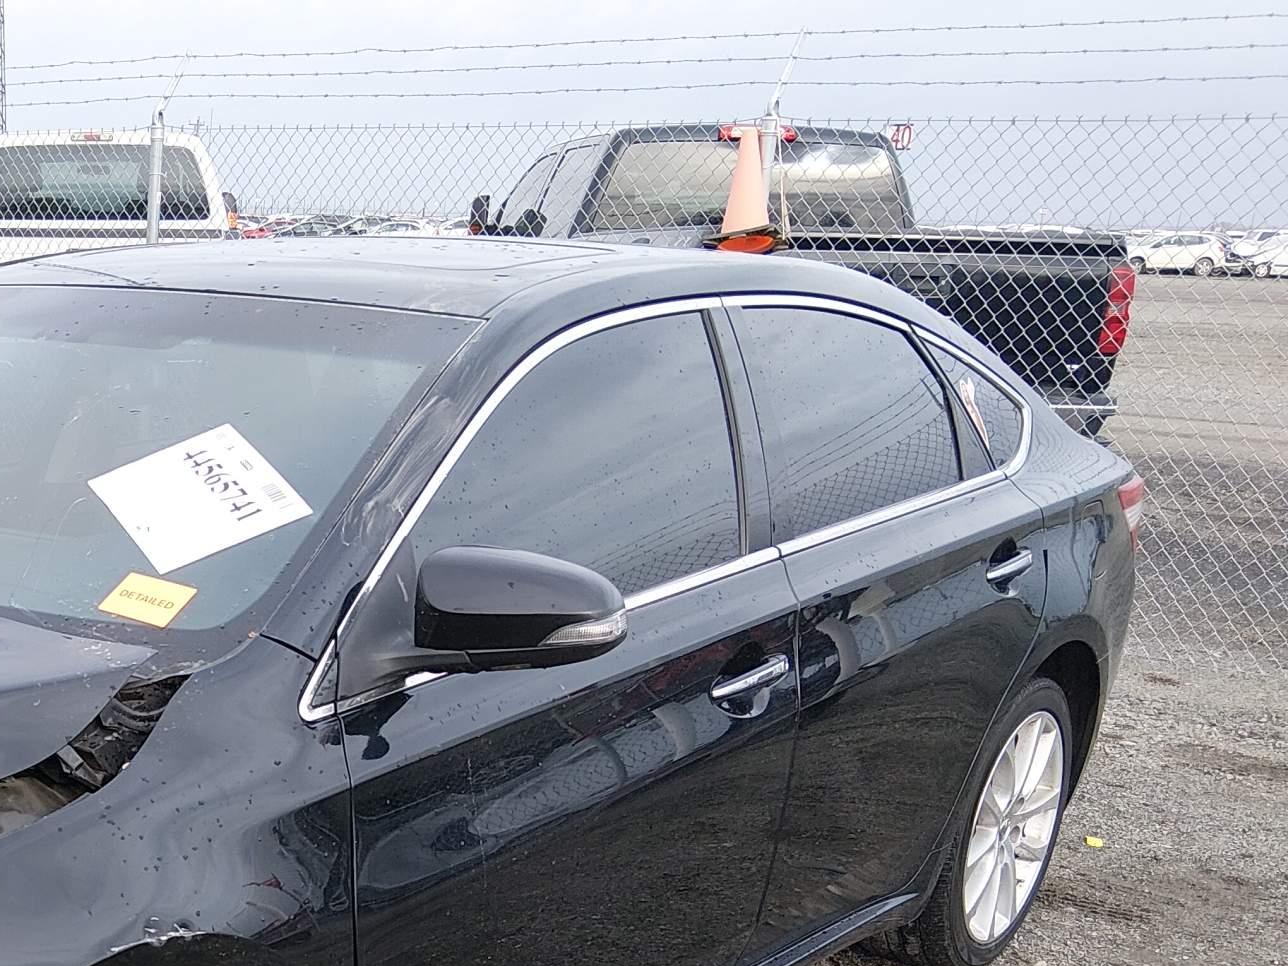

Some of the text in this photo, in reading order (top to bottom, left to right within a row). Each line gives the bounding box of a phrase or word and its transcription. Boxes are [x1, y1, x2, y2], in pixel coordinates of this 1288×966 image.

[891, 125, 912, 150] 40
[183, 450, 262, 521] 44565741
[119, 589, 175, 609] DETAILED
